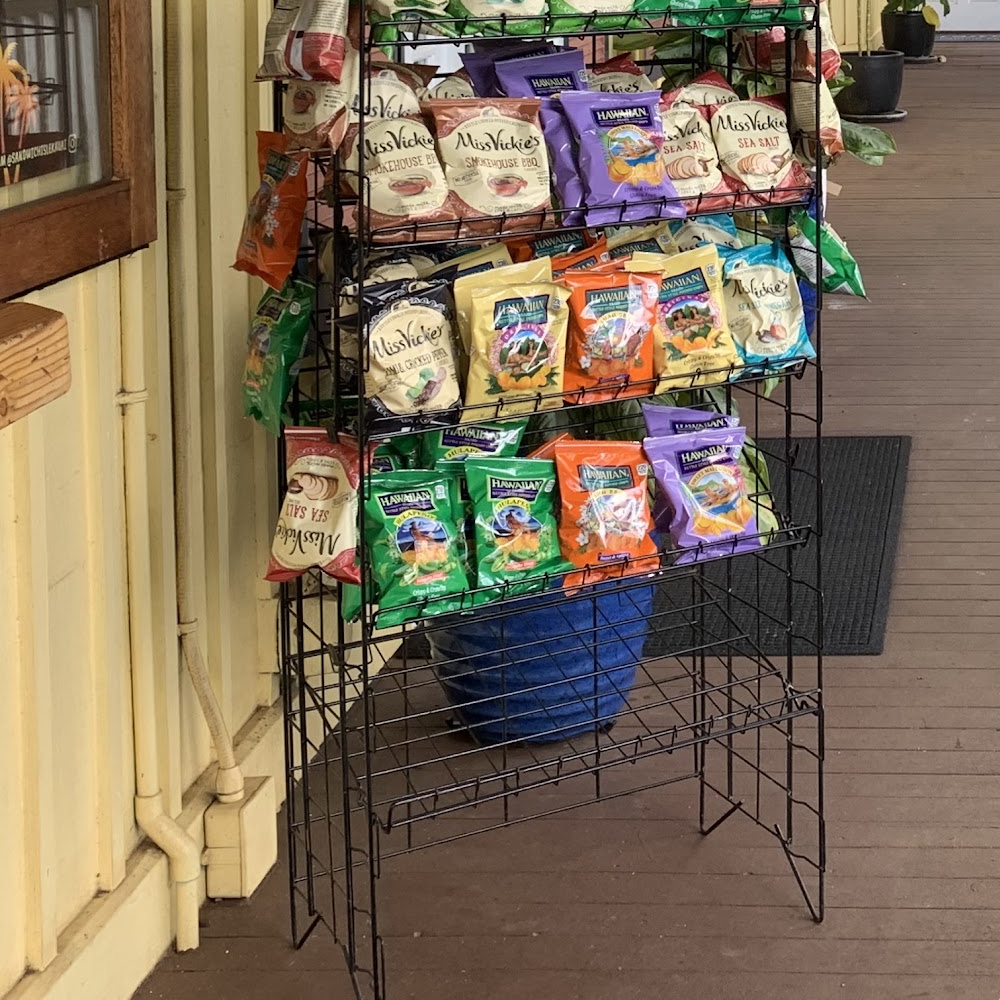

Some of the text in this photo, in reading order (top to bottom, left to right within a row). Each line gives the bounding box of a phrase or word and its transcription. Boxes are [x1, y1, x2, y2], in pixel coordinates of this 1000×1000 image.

[531, 77, 573, 88] HAWAIIAN
[597, 108, 648, 121] HAWAIIAN
[717, 115, 750, 133] Miss
[455, 129, 540, 155] Miss Vickie's
[663, 141, 706, 154] SEA SALT
[738, 136, 780, 149] SEA SALT
[465, 156, 541, 169] SMOKEHOUSE BBQ
[534, 233, 581, 249] HAWAIIAN
[590, 290, 637, 303] HAWAIIAN
[491, 479, 542, 490] HAWAIIAN
[380, 491, 430, 506] HAWAIIAN
[285, 503, 330, 522] SEA SALT
[303, 530, 341, 556] Miss
